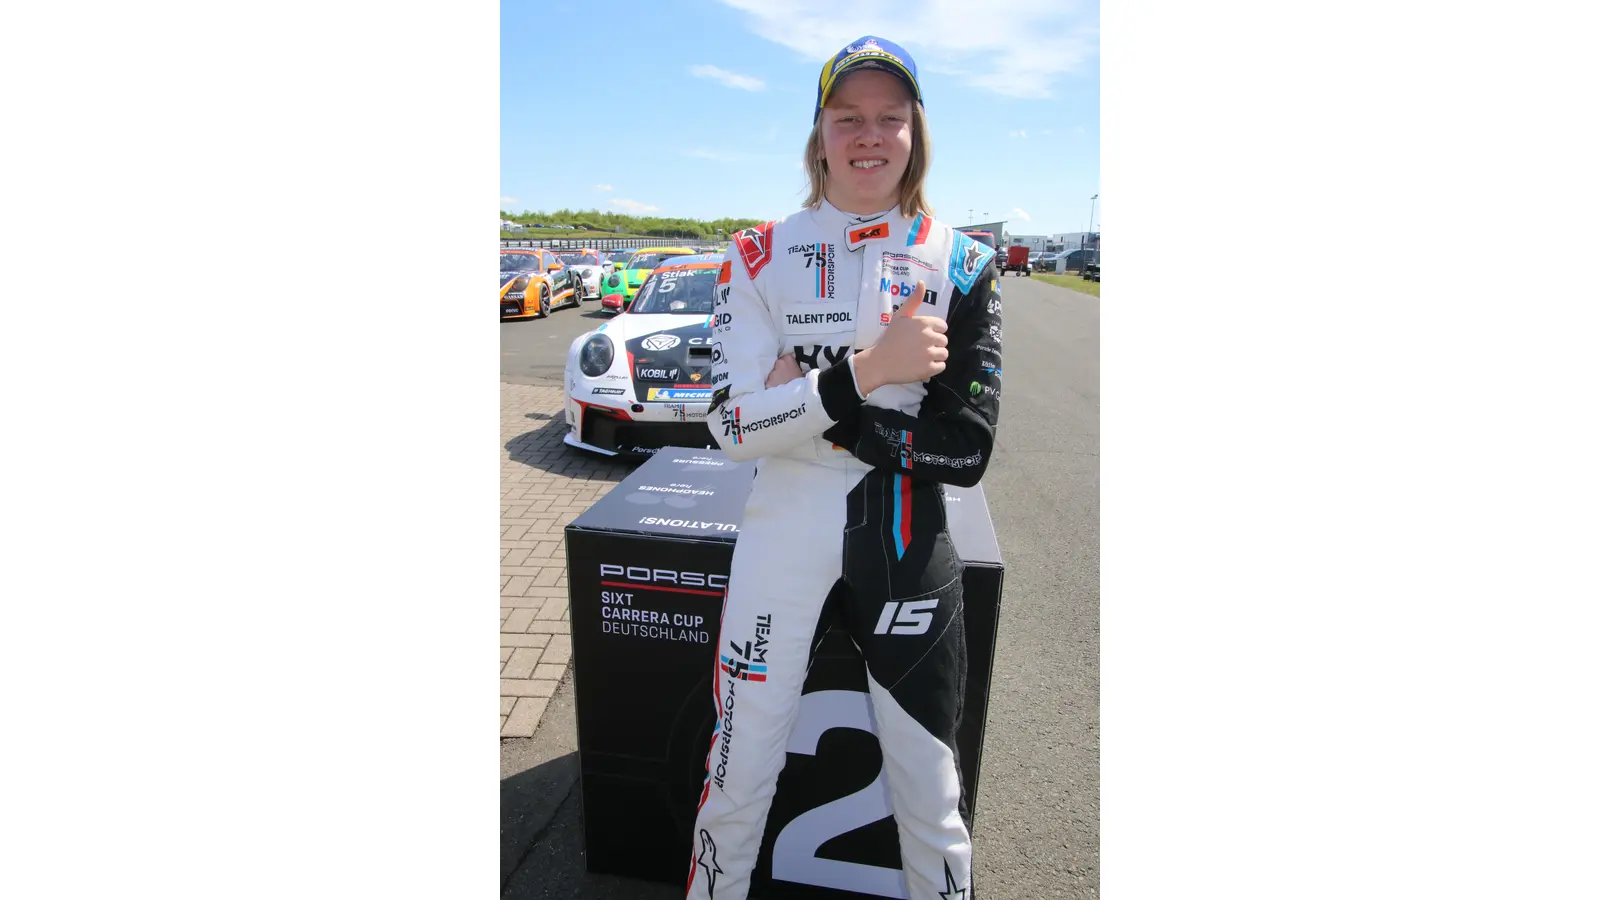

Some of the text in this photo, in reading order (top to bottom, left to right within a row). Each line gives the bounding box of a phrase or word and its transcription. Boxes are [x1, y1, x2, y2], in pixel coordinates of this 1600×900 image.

[787, 243, 815, 255] TEAM
[804, 252, 827, 268] 75
[661, 269, 695, 280] Stiak
[786, 312, 852, 325] TALENT POOL
[640, 368, 668, 379] KOBIL
[721, 402, 806, 437] 75 MOTORSPORT
[672, 459, 724, 467] PRESSURE
[638, 485, 715, 496] HEADPHONES
[638, 517, 740, 532] ULATIONS!
[601, 591, 634, 606] SIXT
[602, 606, 704, 628] CARRERA CUP
[874, 599, 939, 635] 15
[602, 621, 709, 644] DEUTSCHLAND
[753, 614, 772, 663] TEAM
[728, 640, 752, 681] 75
[772, 689, 909, 899] 2
